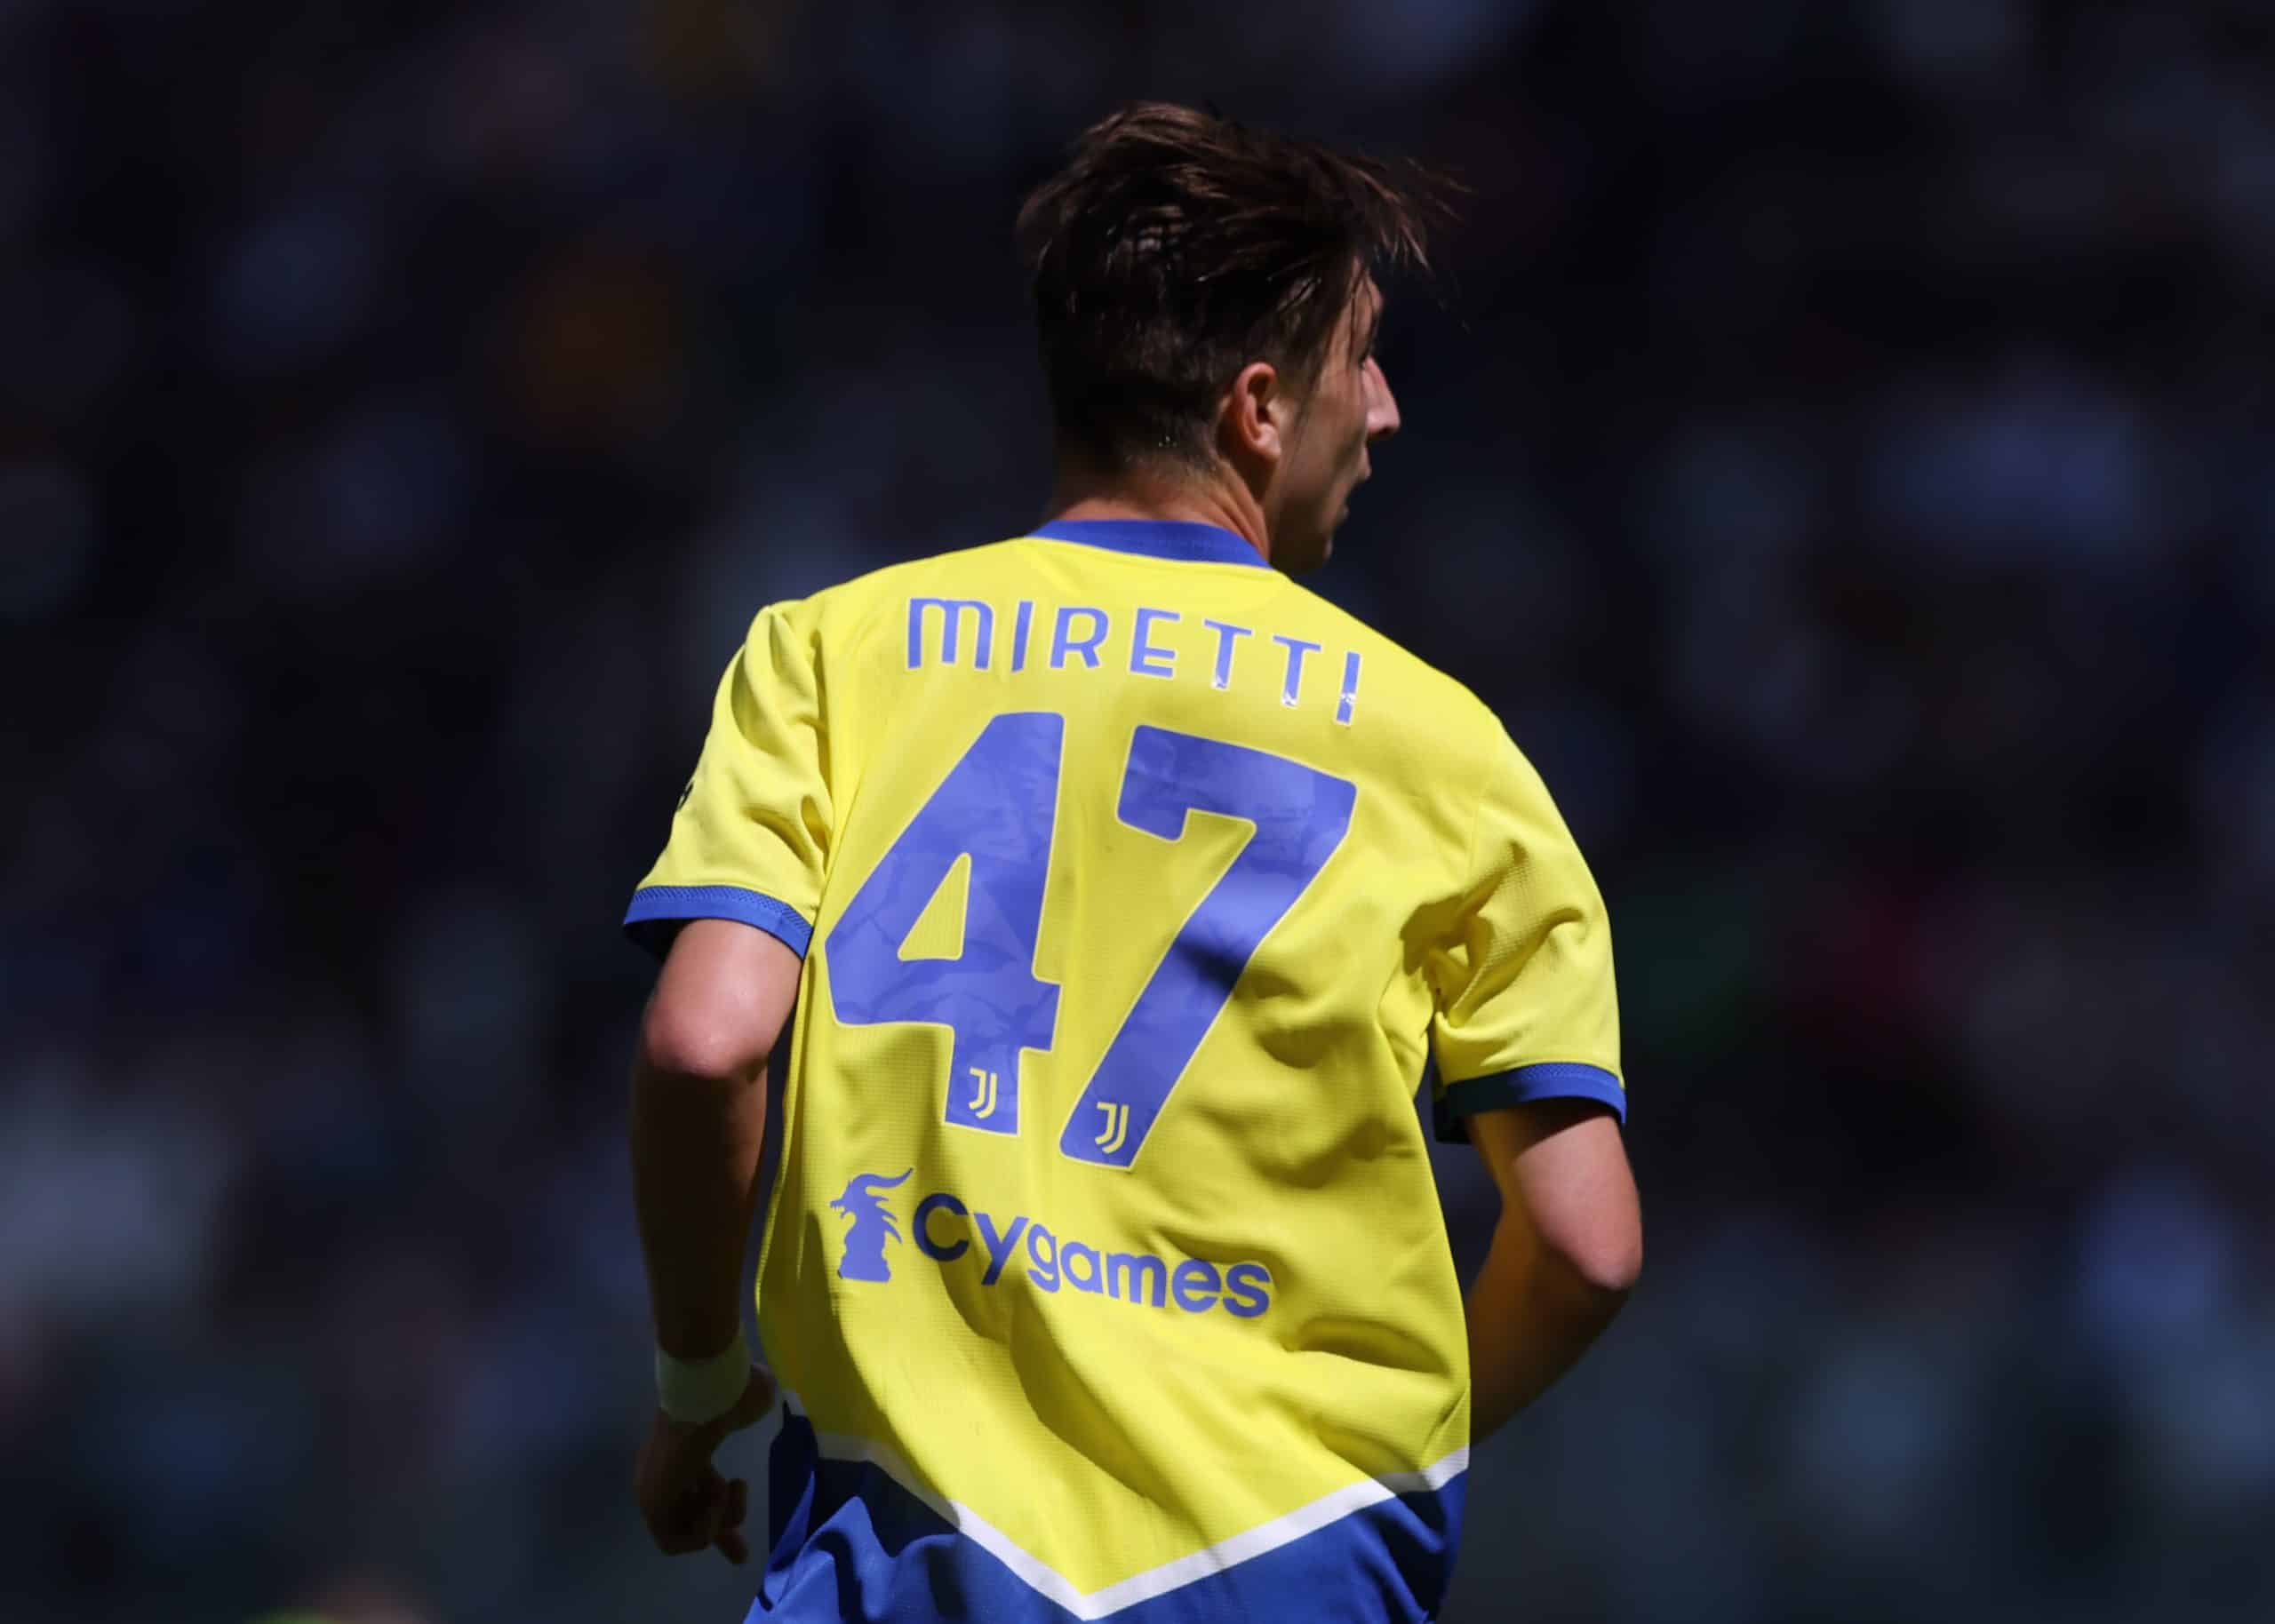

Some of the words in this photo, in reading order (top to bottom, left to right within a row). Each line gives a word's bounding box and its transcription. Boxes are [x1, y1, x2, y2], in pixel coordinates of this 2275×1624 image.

[906, 597, 1361, 725] MIRETTI
[826, 712, 1357, 1168] 47
[912, 1192, 1271, 1318] Cygames
